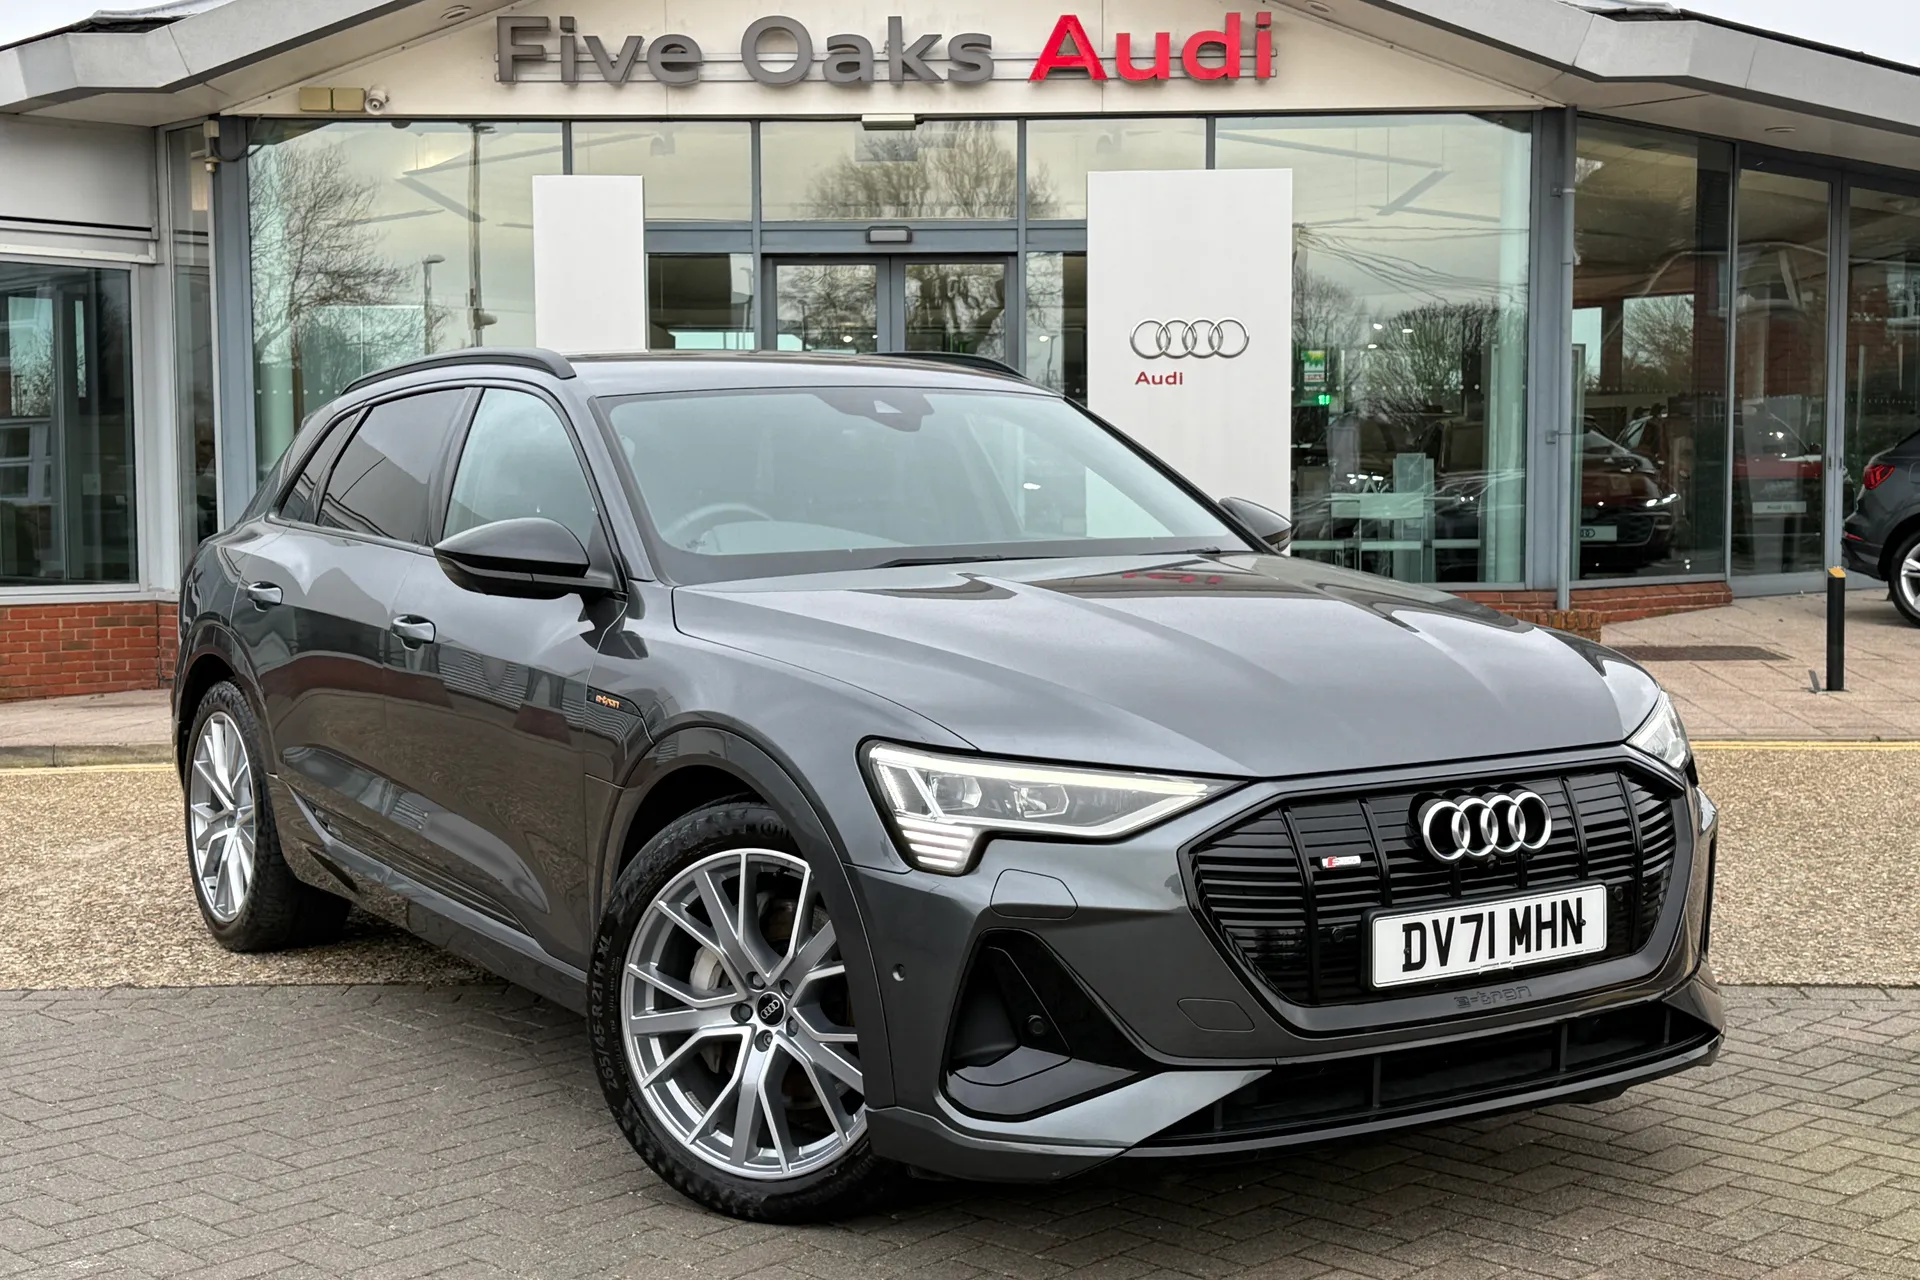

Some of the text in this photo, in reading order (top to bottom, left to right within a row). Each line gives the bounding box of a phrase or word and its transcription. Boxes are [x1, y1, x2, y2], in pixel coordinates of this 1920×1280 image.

[497, 12, 1272, 86] Five Oaks Audi
[1134, 371, 1184, 386] Audi
[1402, 897, 1587, 973] DV71 MHN
